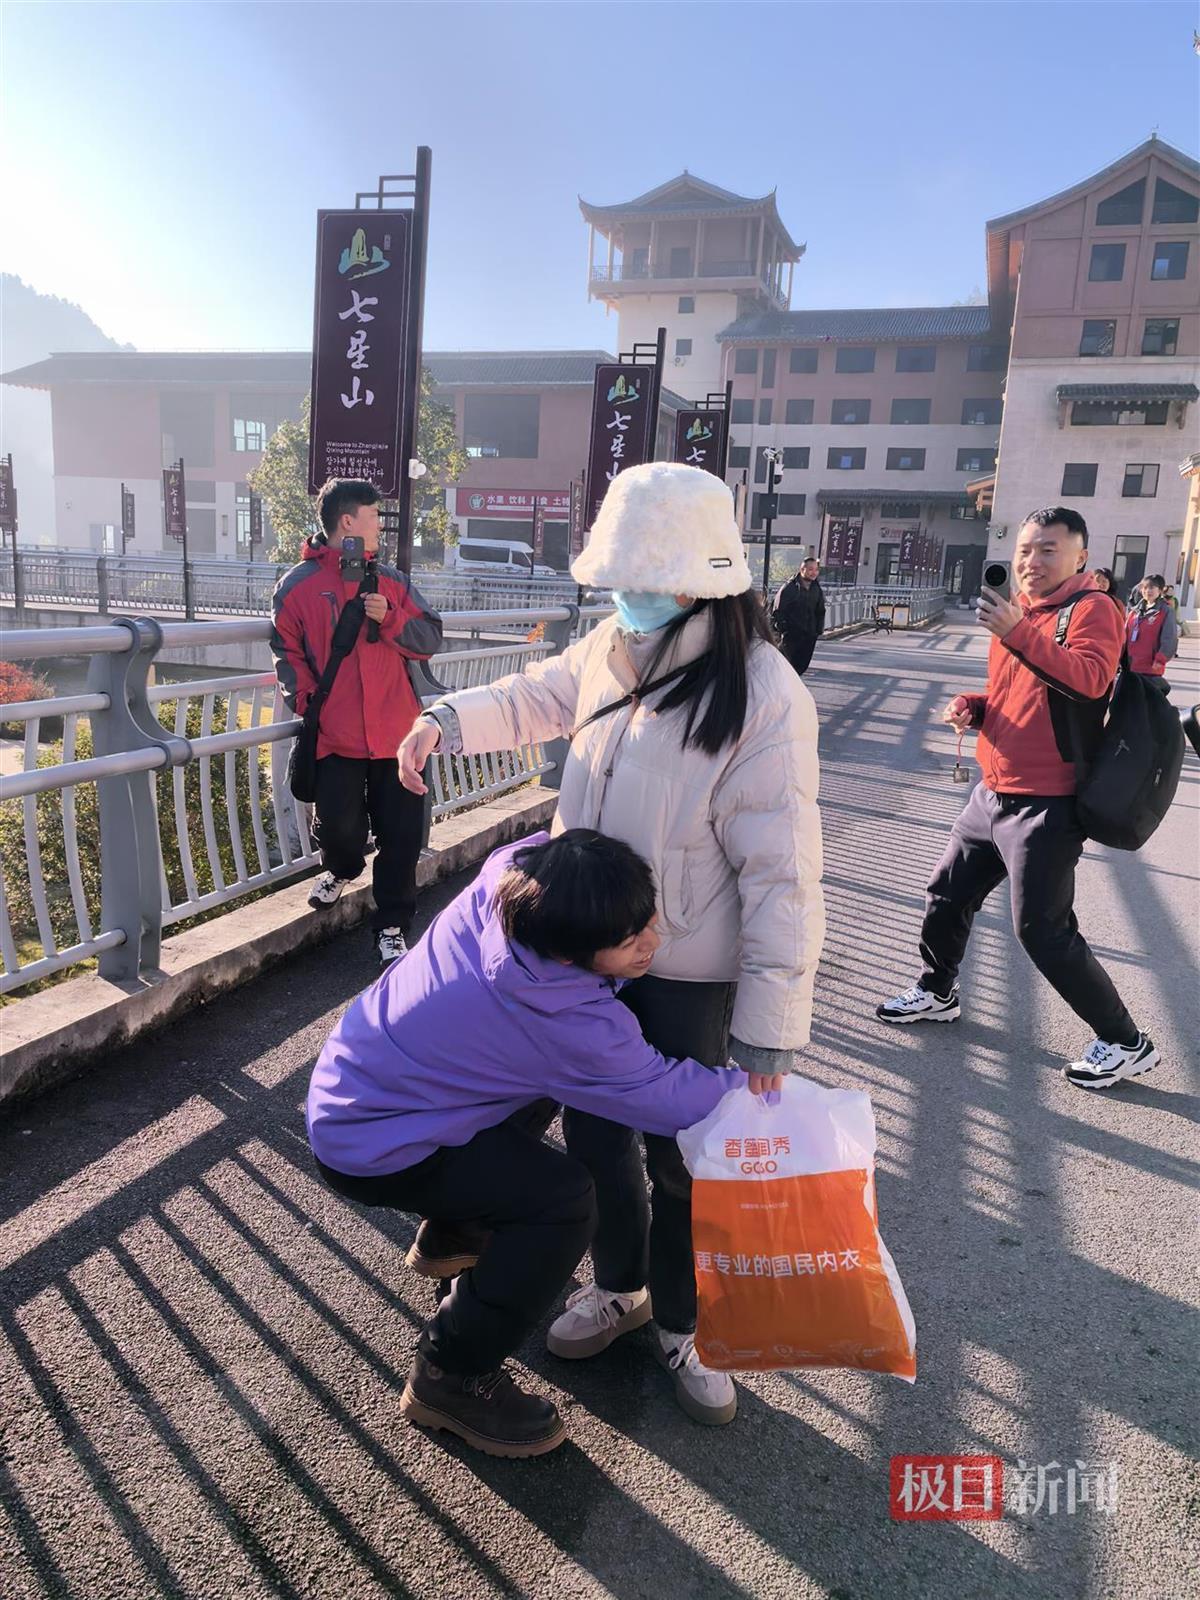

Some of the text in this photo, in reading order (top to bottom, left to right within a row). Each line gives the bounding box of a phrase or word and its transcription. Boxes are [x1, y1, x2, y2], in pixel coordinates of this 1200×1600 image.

[338, 290, 379, 409] 七星山
[695, 1249, 861, 1278] 更专业的国民内衣
